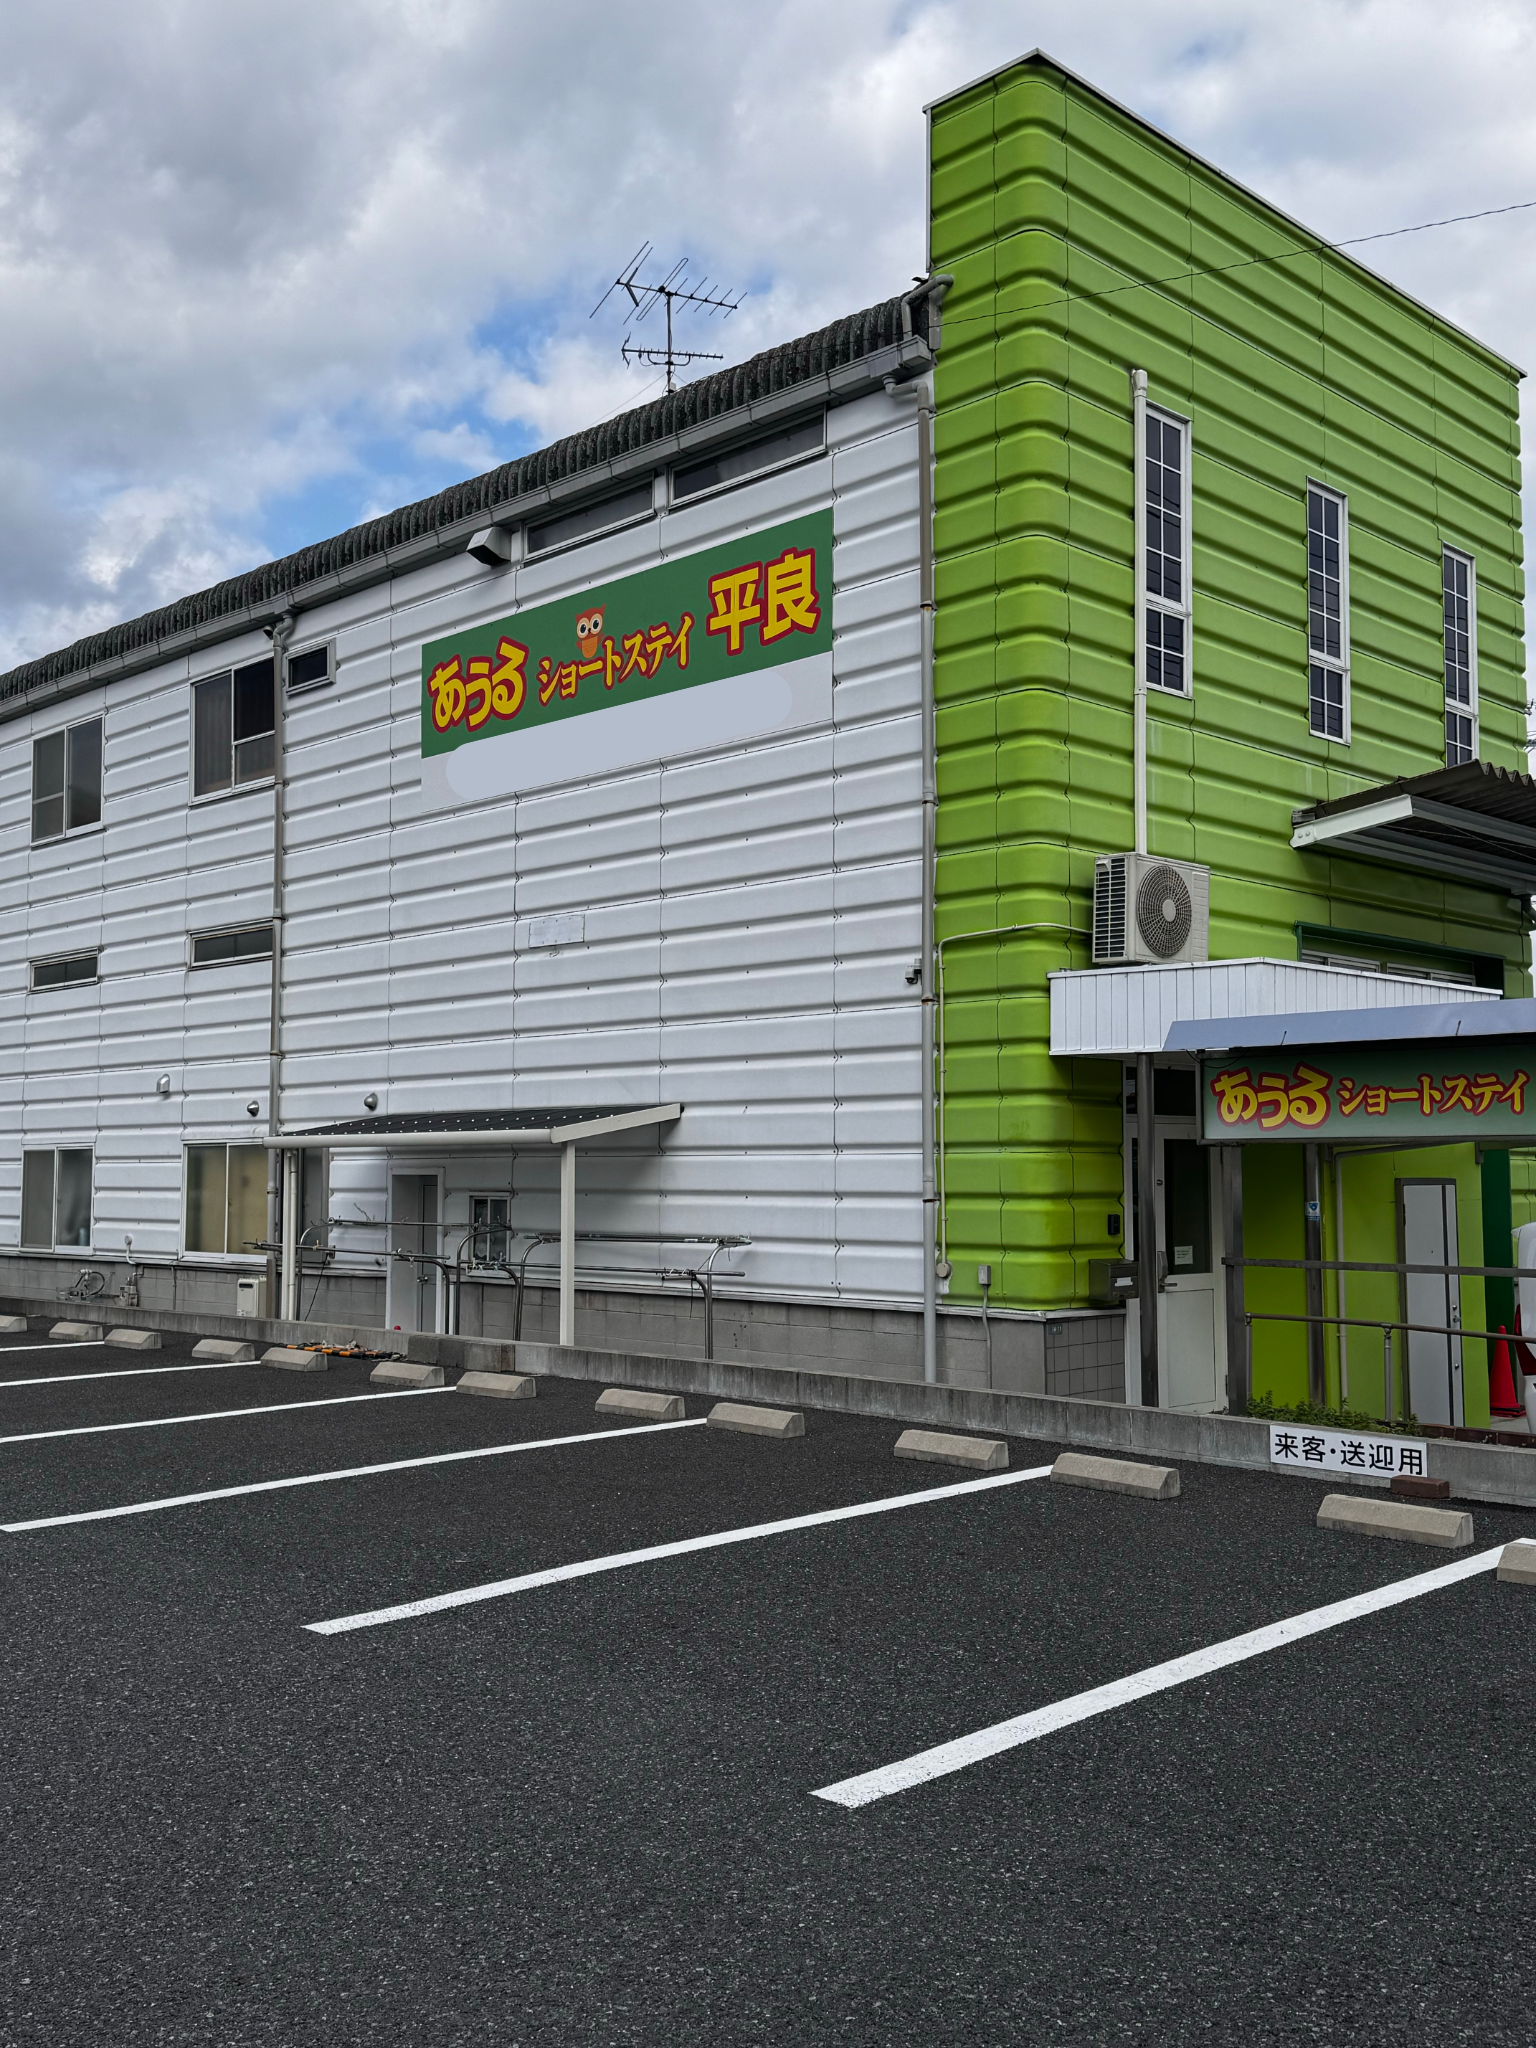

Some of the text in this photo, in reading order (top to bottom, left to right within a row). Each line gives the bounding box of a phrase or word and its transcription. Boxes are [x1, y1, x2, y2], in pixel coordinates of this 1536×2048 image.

[428, 548, 820, 732] あうる ショートステイ 平良
[1211, 1062, 1530, 1131] あうる ショートステイ
[1274, 1432, 1423, 1476] 来客・送迎用
